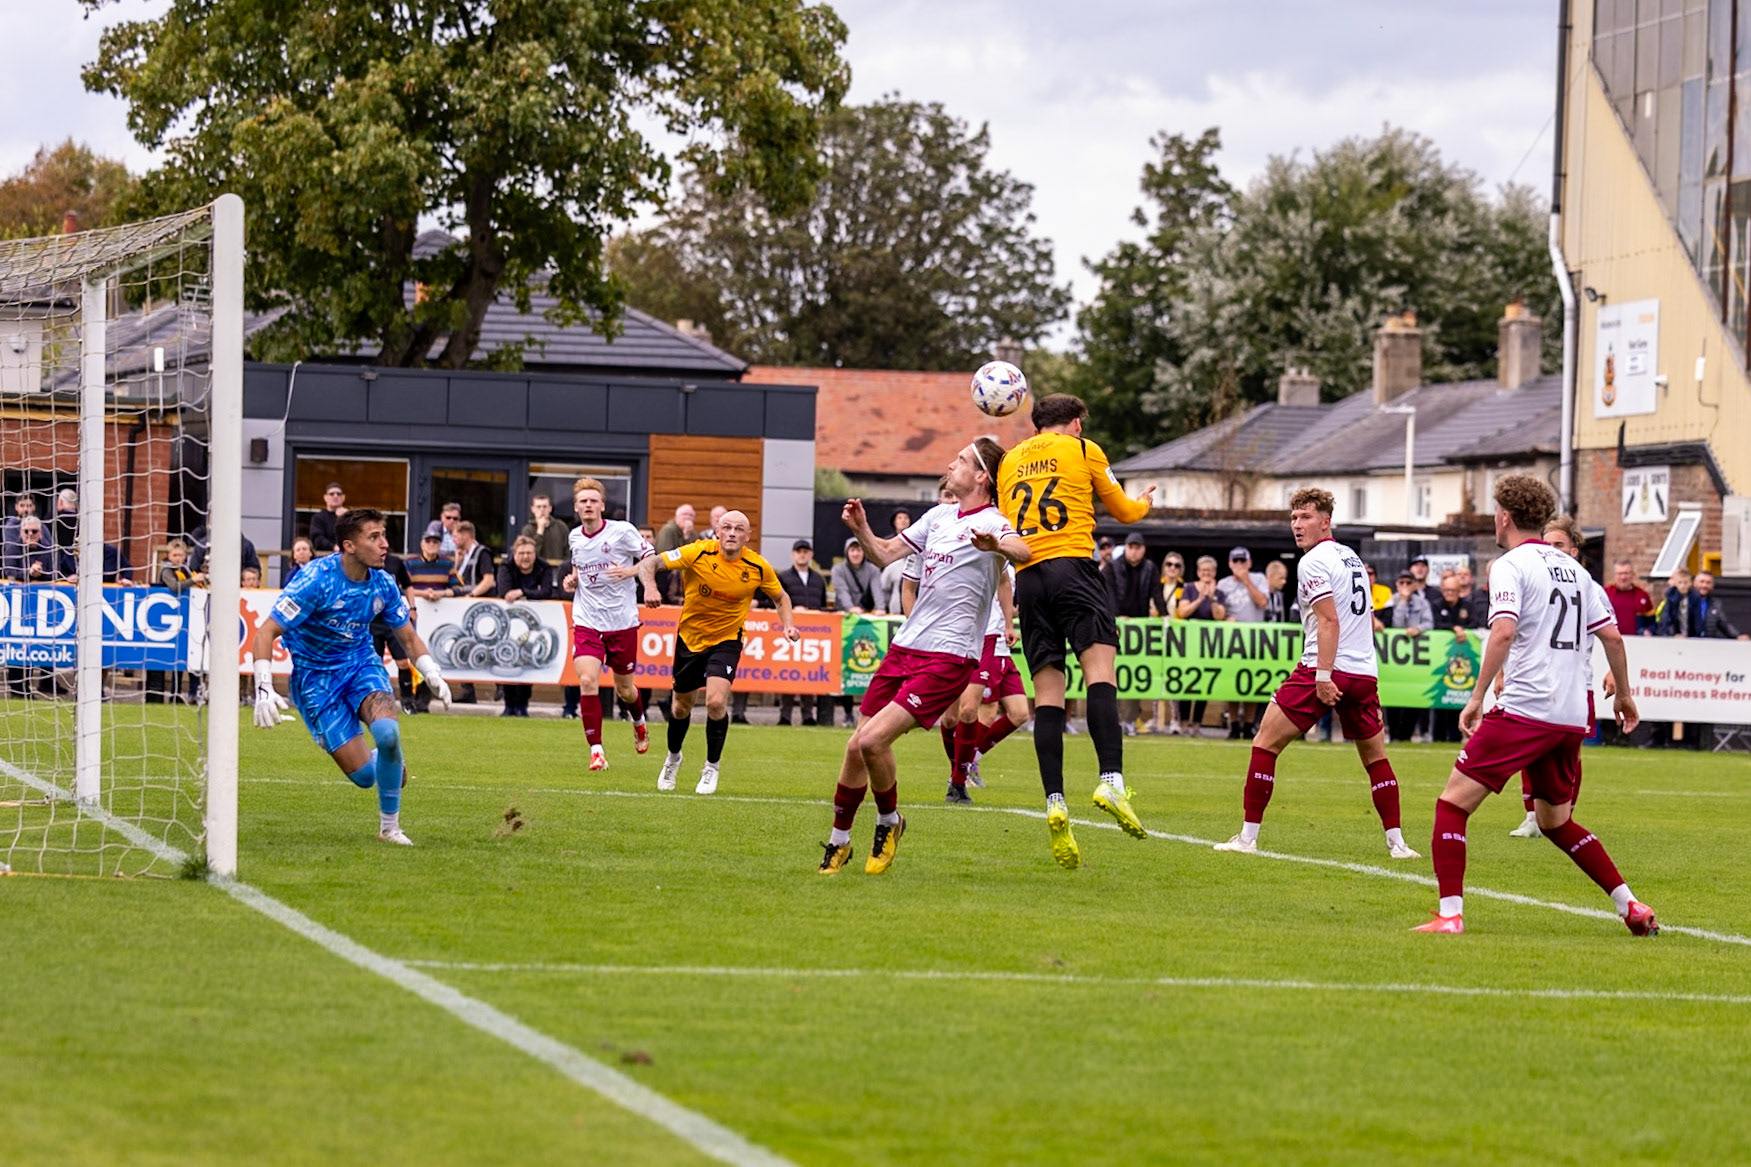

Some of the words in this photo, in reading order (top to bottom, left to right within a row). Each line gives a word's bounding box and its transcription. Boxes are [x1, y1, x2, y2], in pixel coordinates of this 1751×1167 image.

[1017, 458, 1058, 478] SIMMS
[1011, 477, 1069, 536] 26
[1547, 566, 1577, 584] KELLY
[1350, 571, 1367, 616] 5
[0, 588, 183, 642] LDNG
[771, 623, 832, 633] Coonents
[1549, 587, 1581, 652] 21
[771, 638, 832, 663] 2151
[1200, 627, 1431, 666] MAINTNCE
[1165, 666, 1222, 695] 827
[1640, 668, 1671, 680] Real
[1674, 670, 1721, 685] Money
[1725, 671, 1746, 682] for
[1644, 686, 1707, 699] Business
